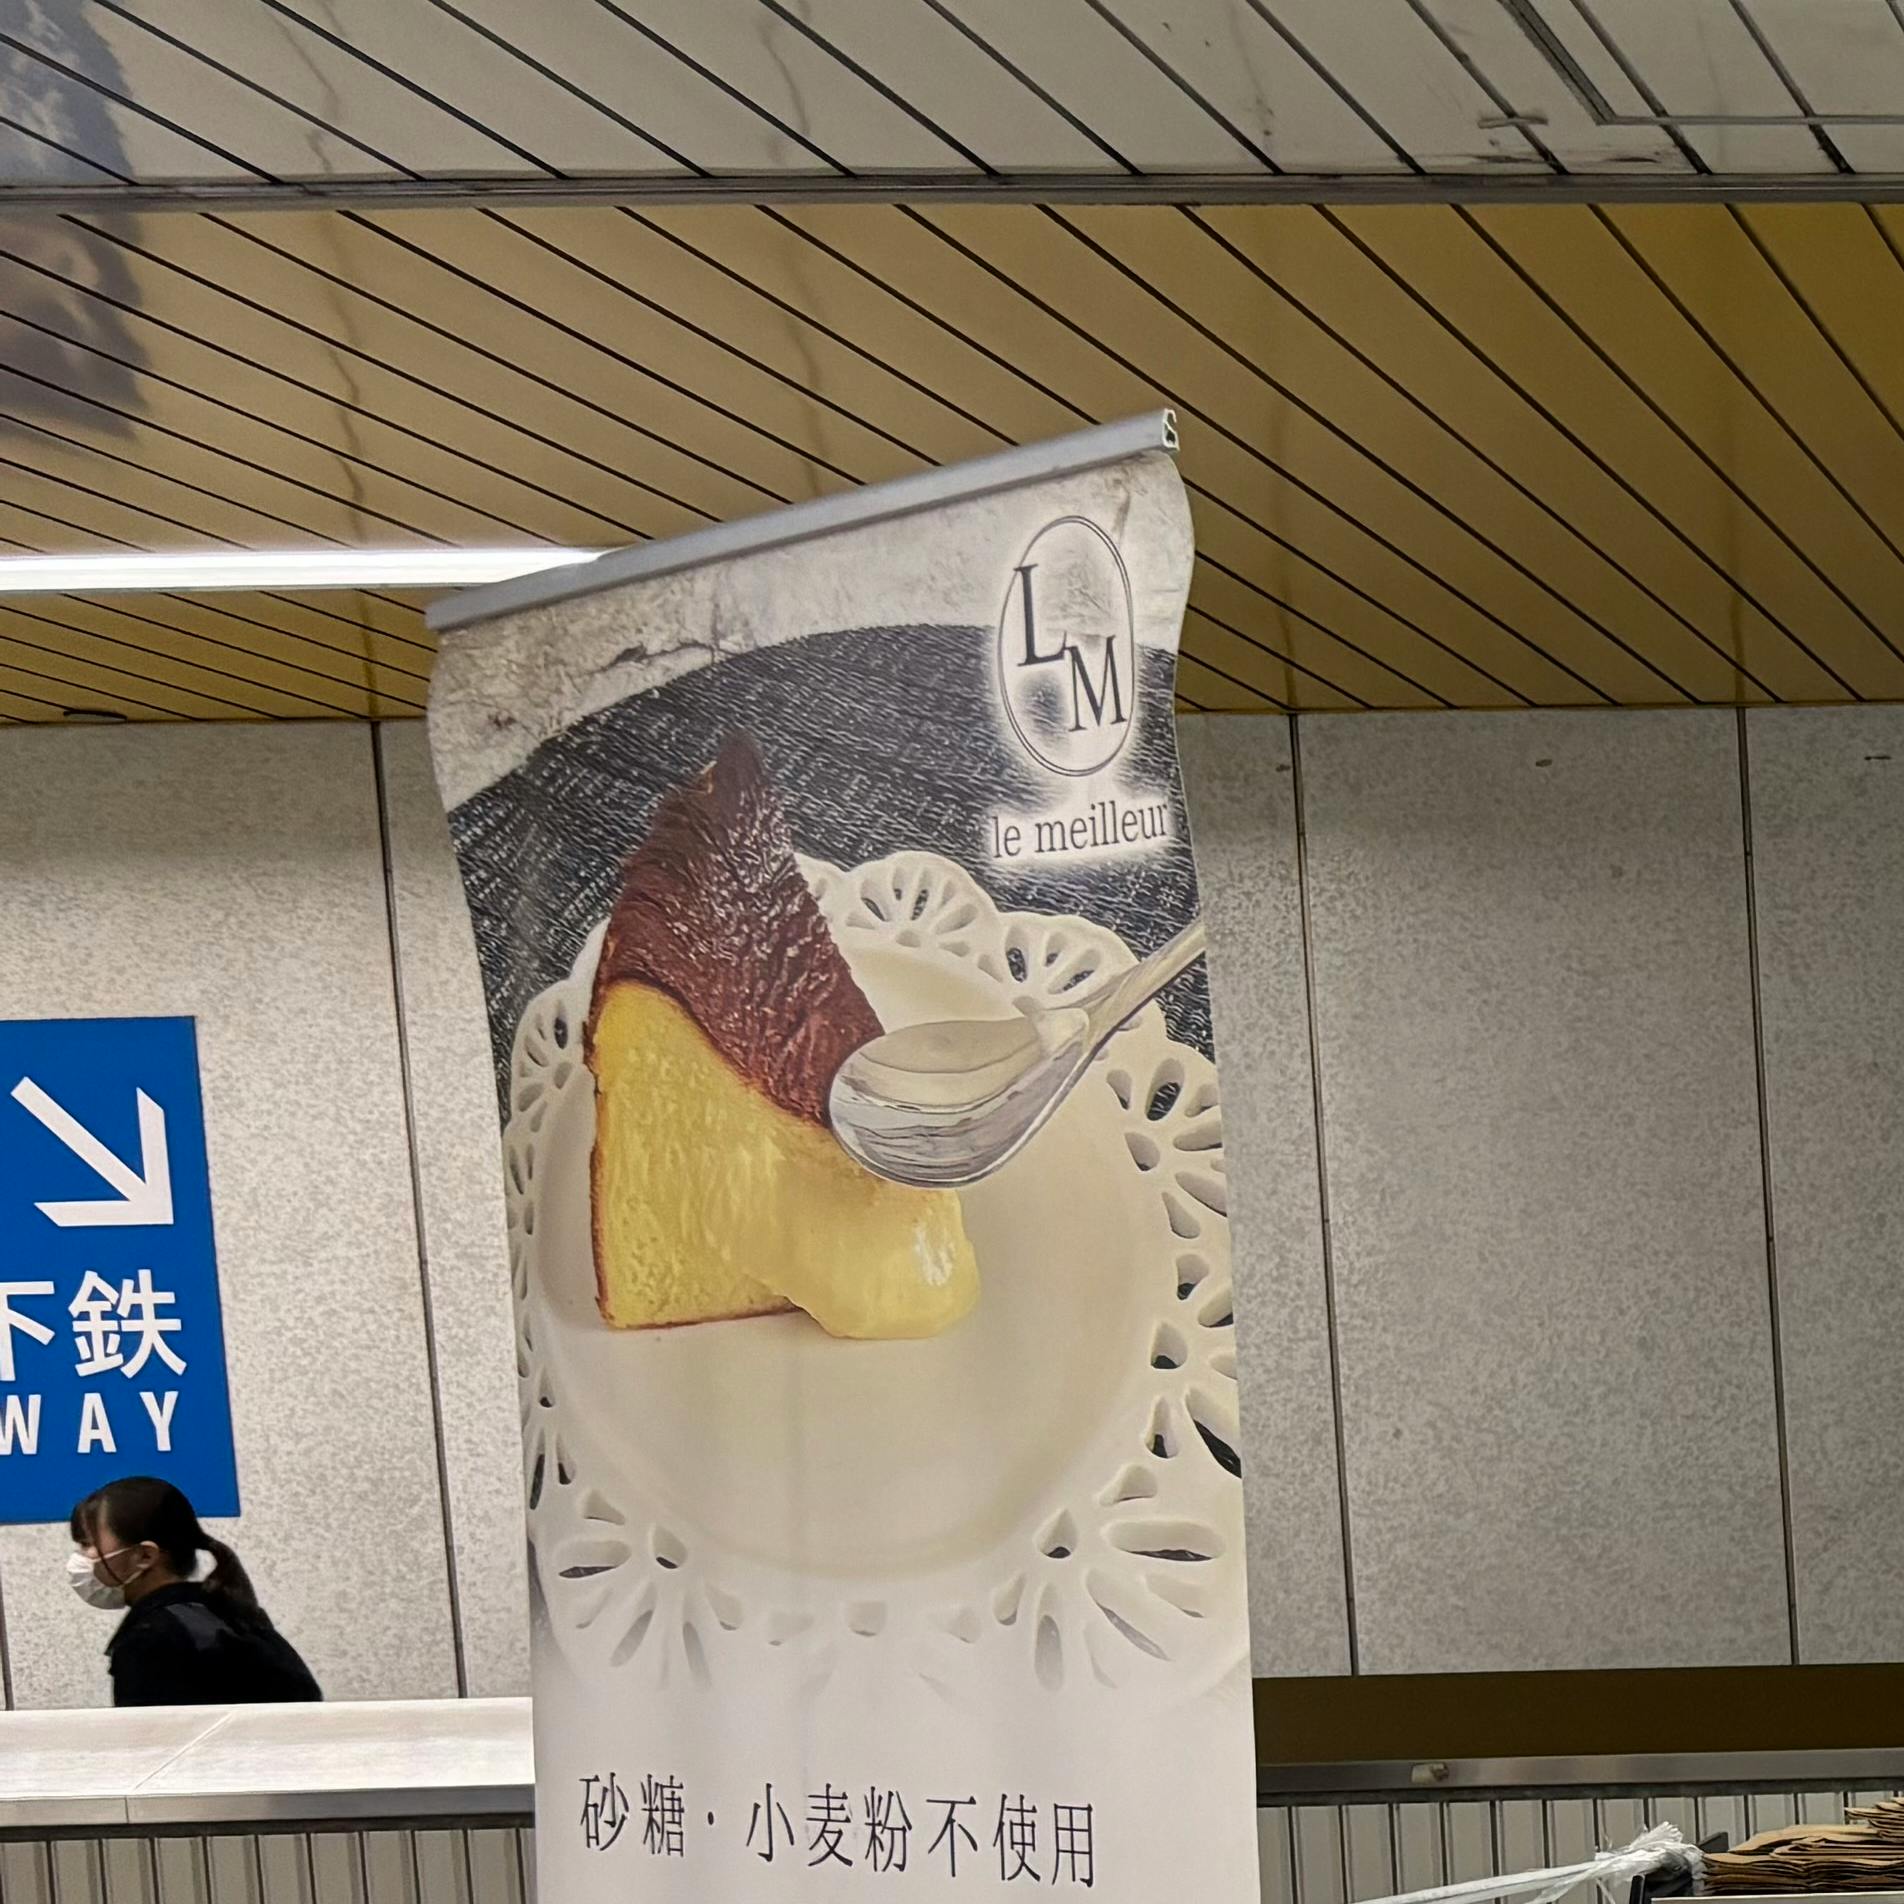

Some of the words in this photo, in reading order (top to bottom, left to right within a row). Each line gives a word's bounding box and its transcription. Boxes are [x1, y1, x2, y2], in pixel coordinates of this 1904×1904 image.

[993, 816, 1021, 858] le
[1034, 799, 1170, 853] meilleur
[578, 1772, 1096, 1889] 砂糖・小麦粉不使用
